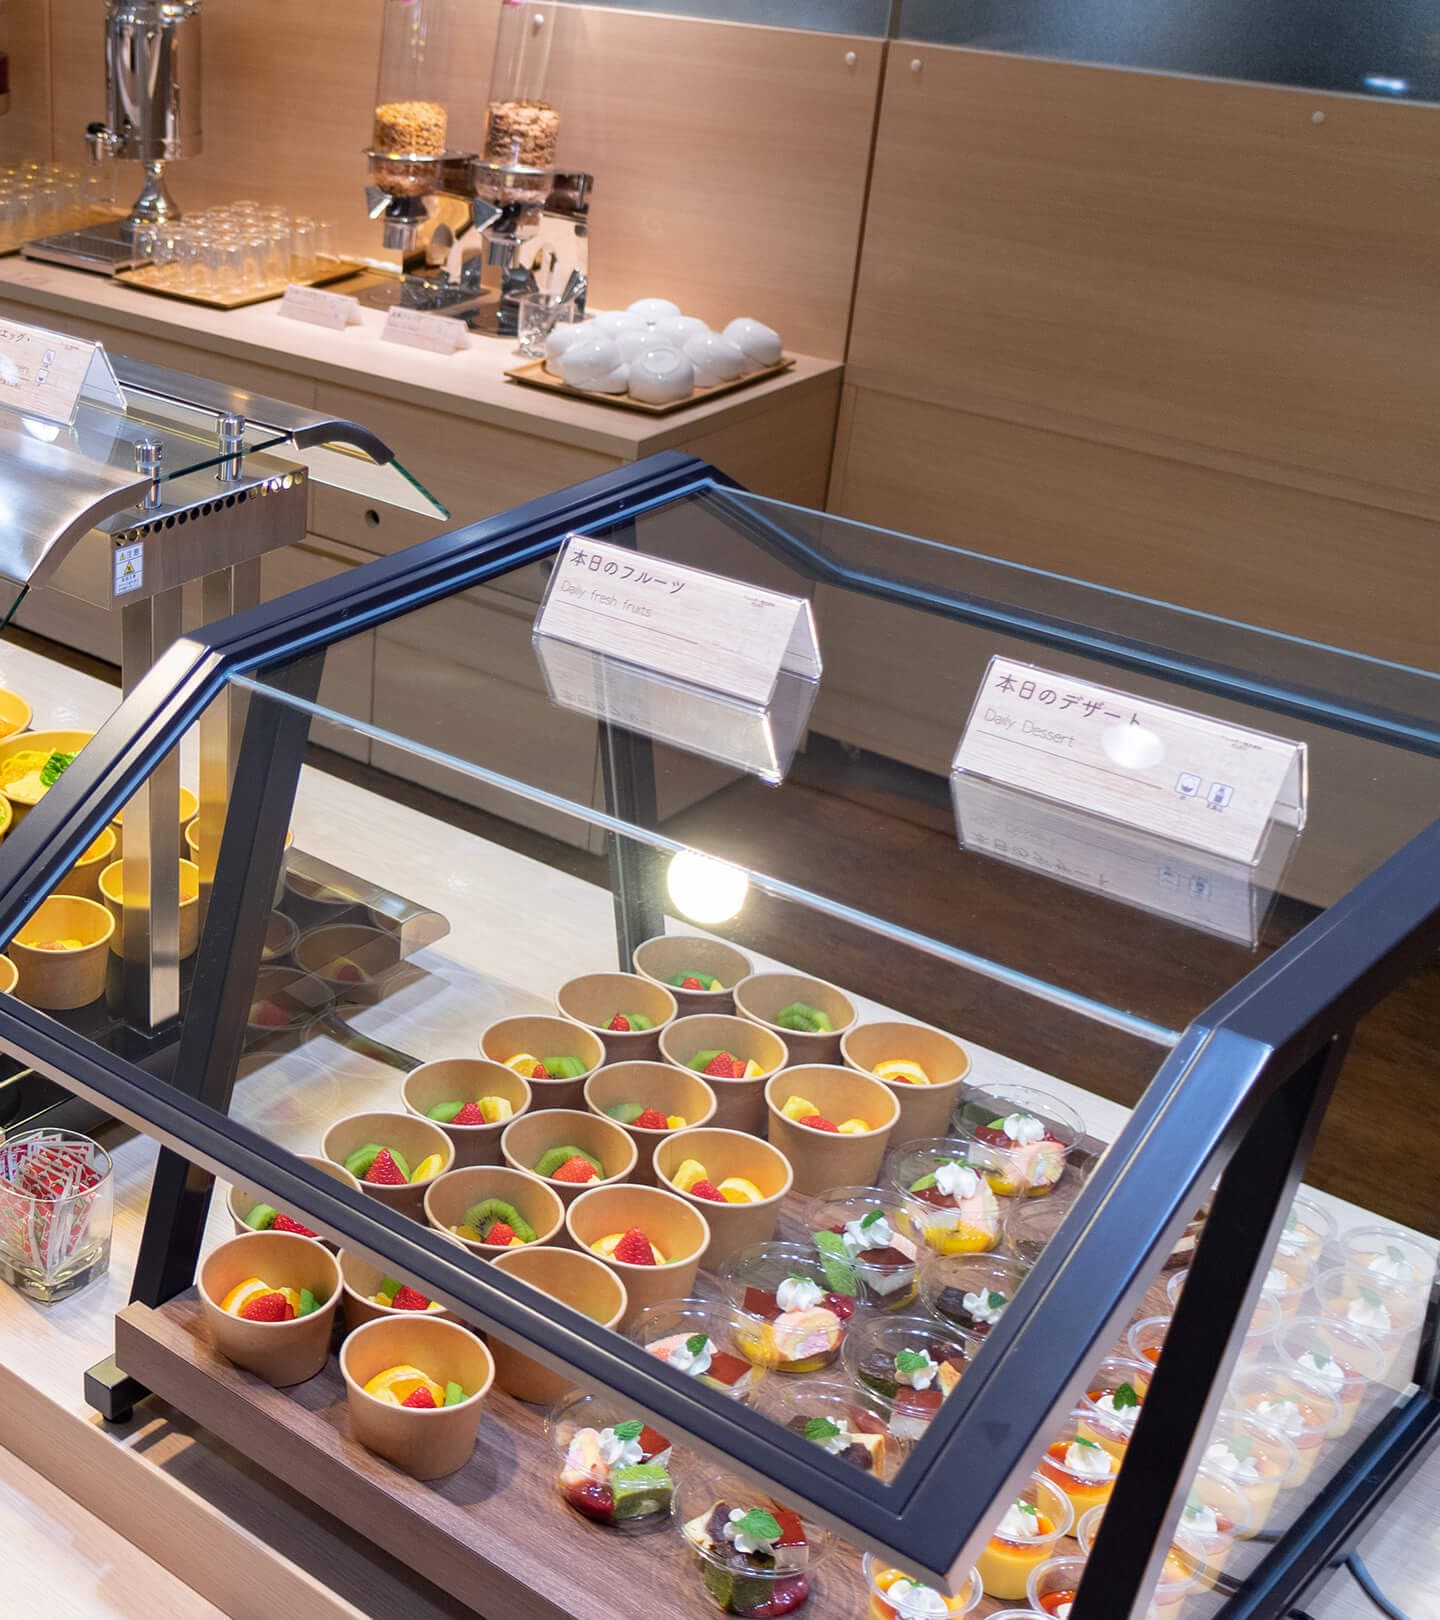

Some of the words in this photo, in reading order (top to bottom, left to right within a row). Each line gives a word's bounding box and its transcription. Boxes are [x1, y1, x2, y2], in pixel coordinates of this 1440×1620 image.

[570, 549, 686, 594] 本日のフルーツ
[560, 580, 585, 599] Daily
[591, 590, 617, 606] fresh
[623, 599, 652, 617] fruits
[995, 673, 1141, 726] 本日のデザート
[984, 708, 1016, 730] Daily
[1022, 719, 1075, 748] Dessert
